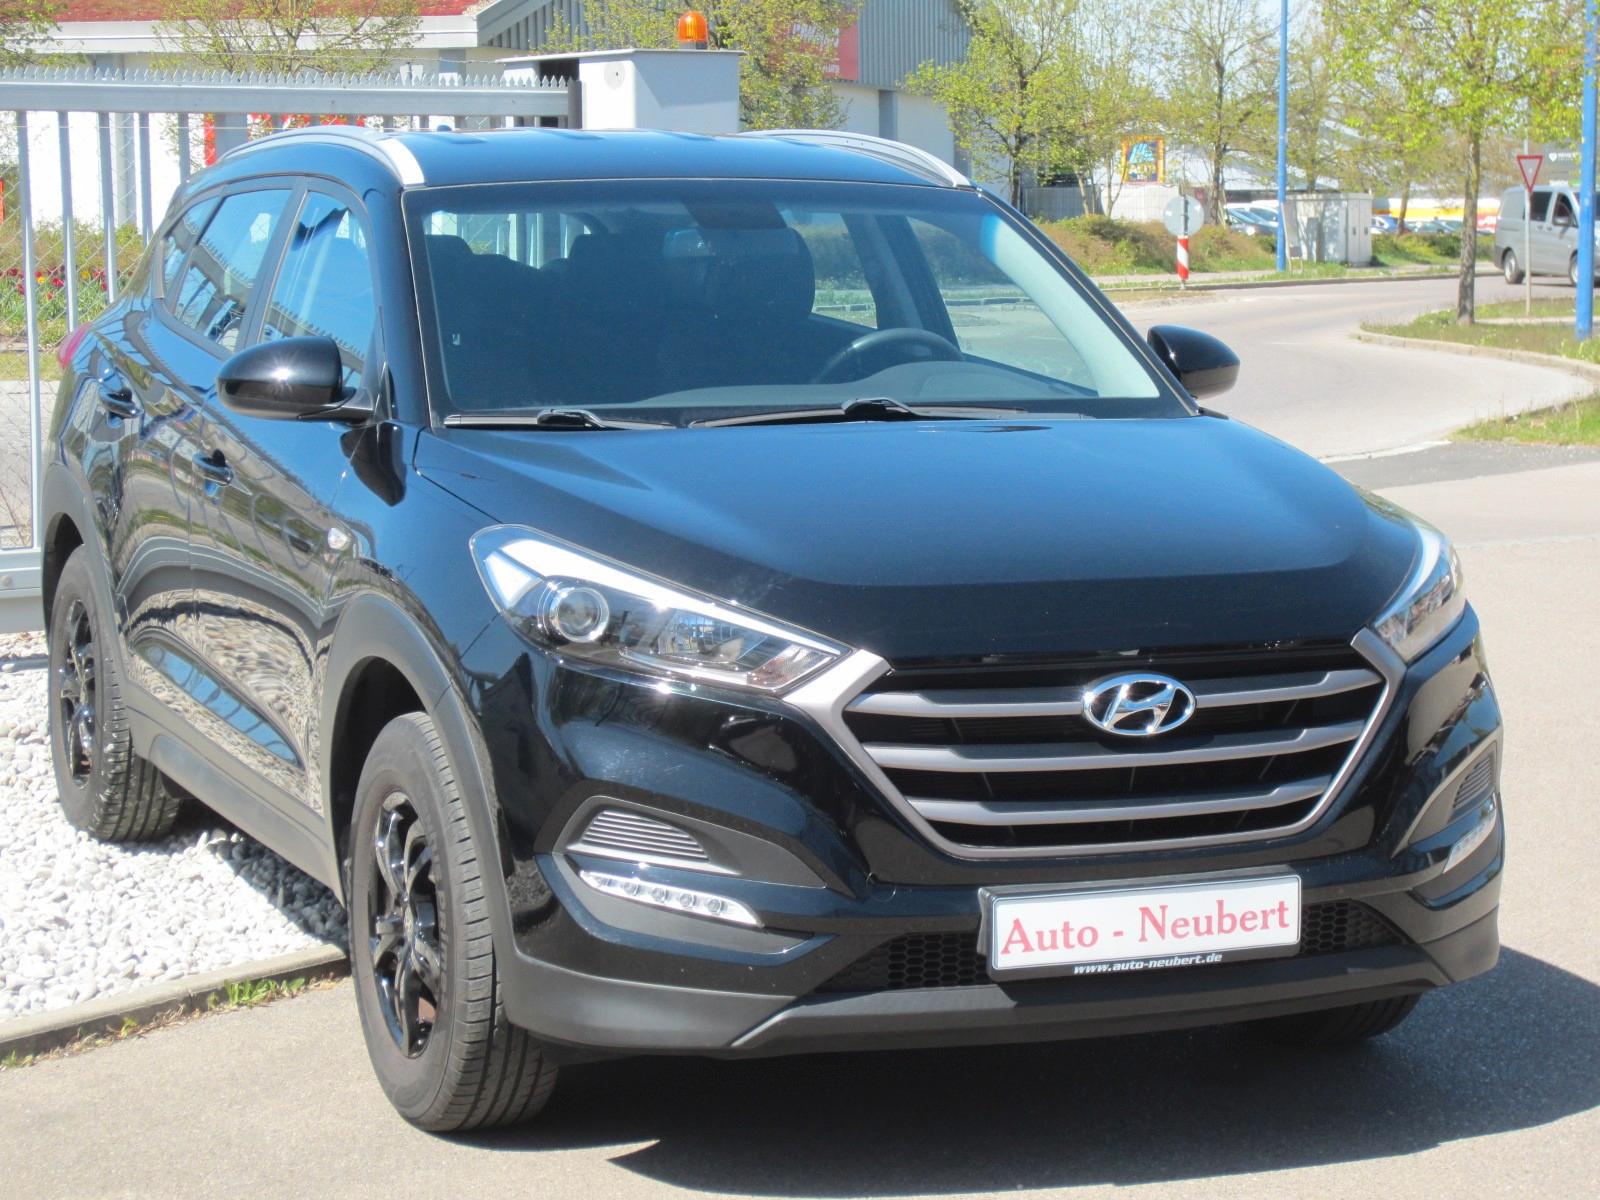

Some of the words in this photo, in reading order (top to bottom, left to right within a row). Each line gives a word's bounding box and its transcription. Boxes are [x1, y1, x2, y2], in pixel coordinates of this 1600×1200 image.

[1000, 917, 1099, 955] Auto
[1138, 898, 1290, 943] Neubert
[1073, 952, 1223, 975] www.auto-neubert.de
